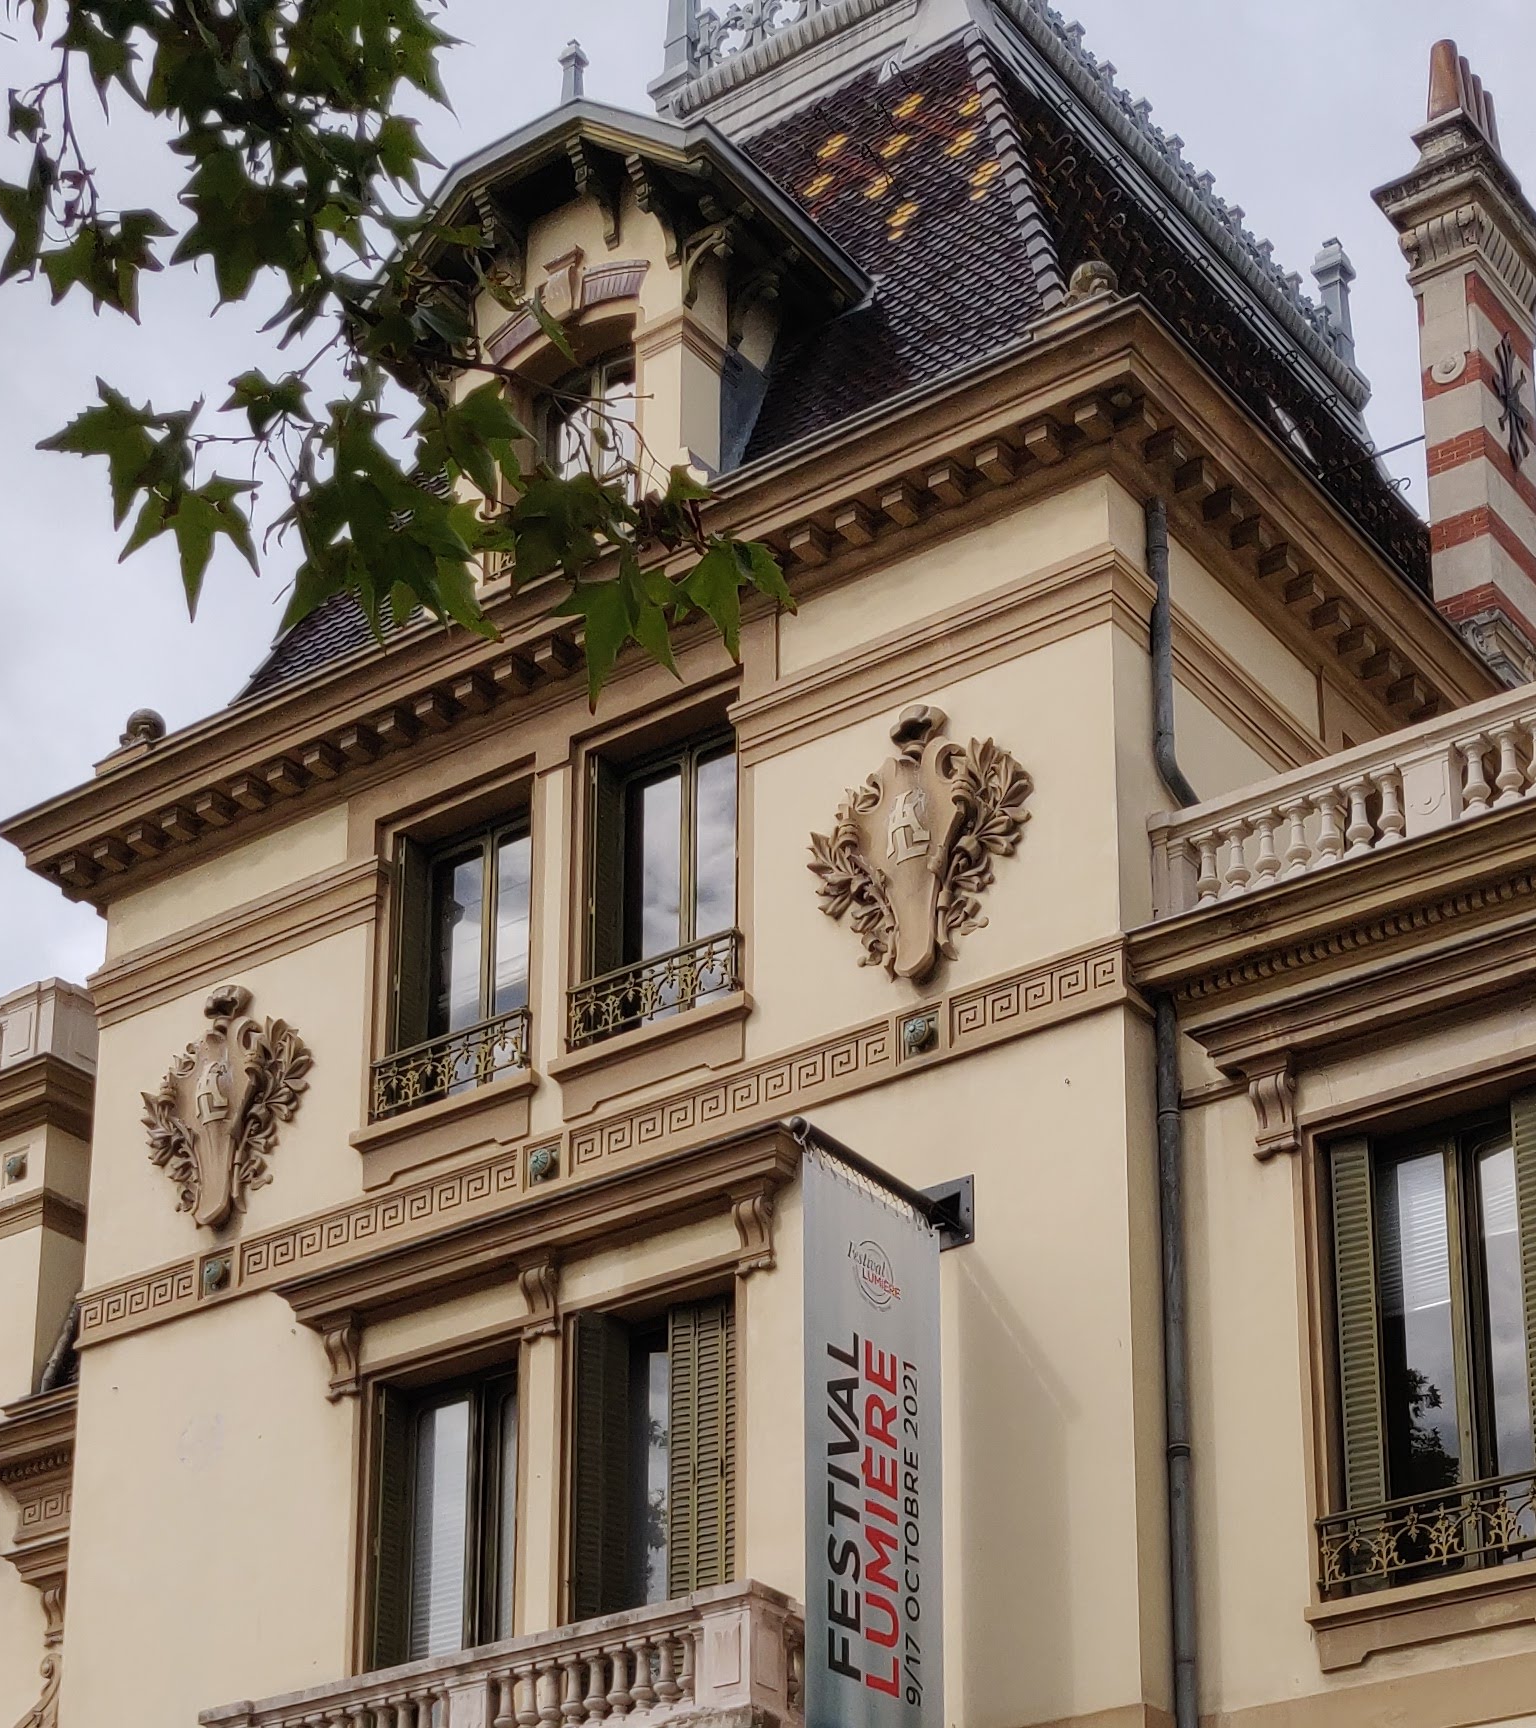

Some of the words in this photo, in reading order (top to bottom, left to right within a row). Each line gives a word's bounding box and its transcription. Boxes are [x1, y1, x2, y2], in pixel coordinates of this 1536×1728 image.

[902, 1362, 920, 1438] 2021
[826, 1332, 862, 1682] FESTIVAL
[861, 1338, 901, 1700] LUMIÈRE
[903, 1451, 921, 1622] OCTOBRE
[905, 1636, 922, 1708] 9/17
